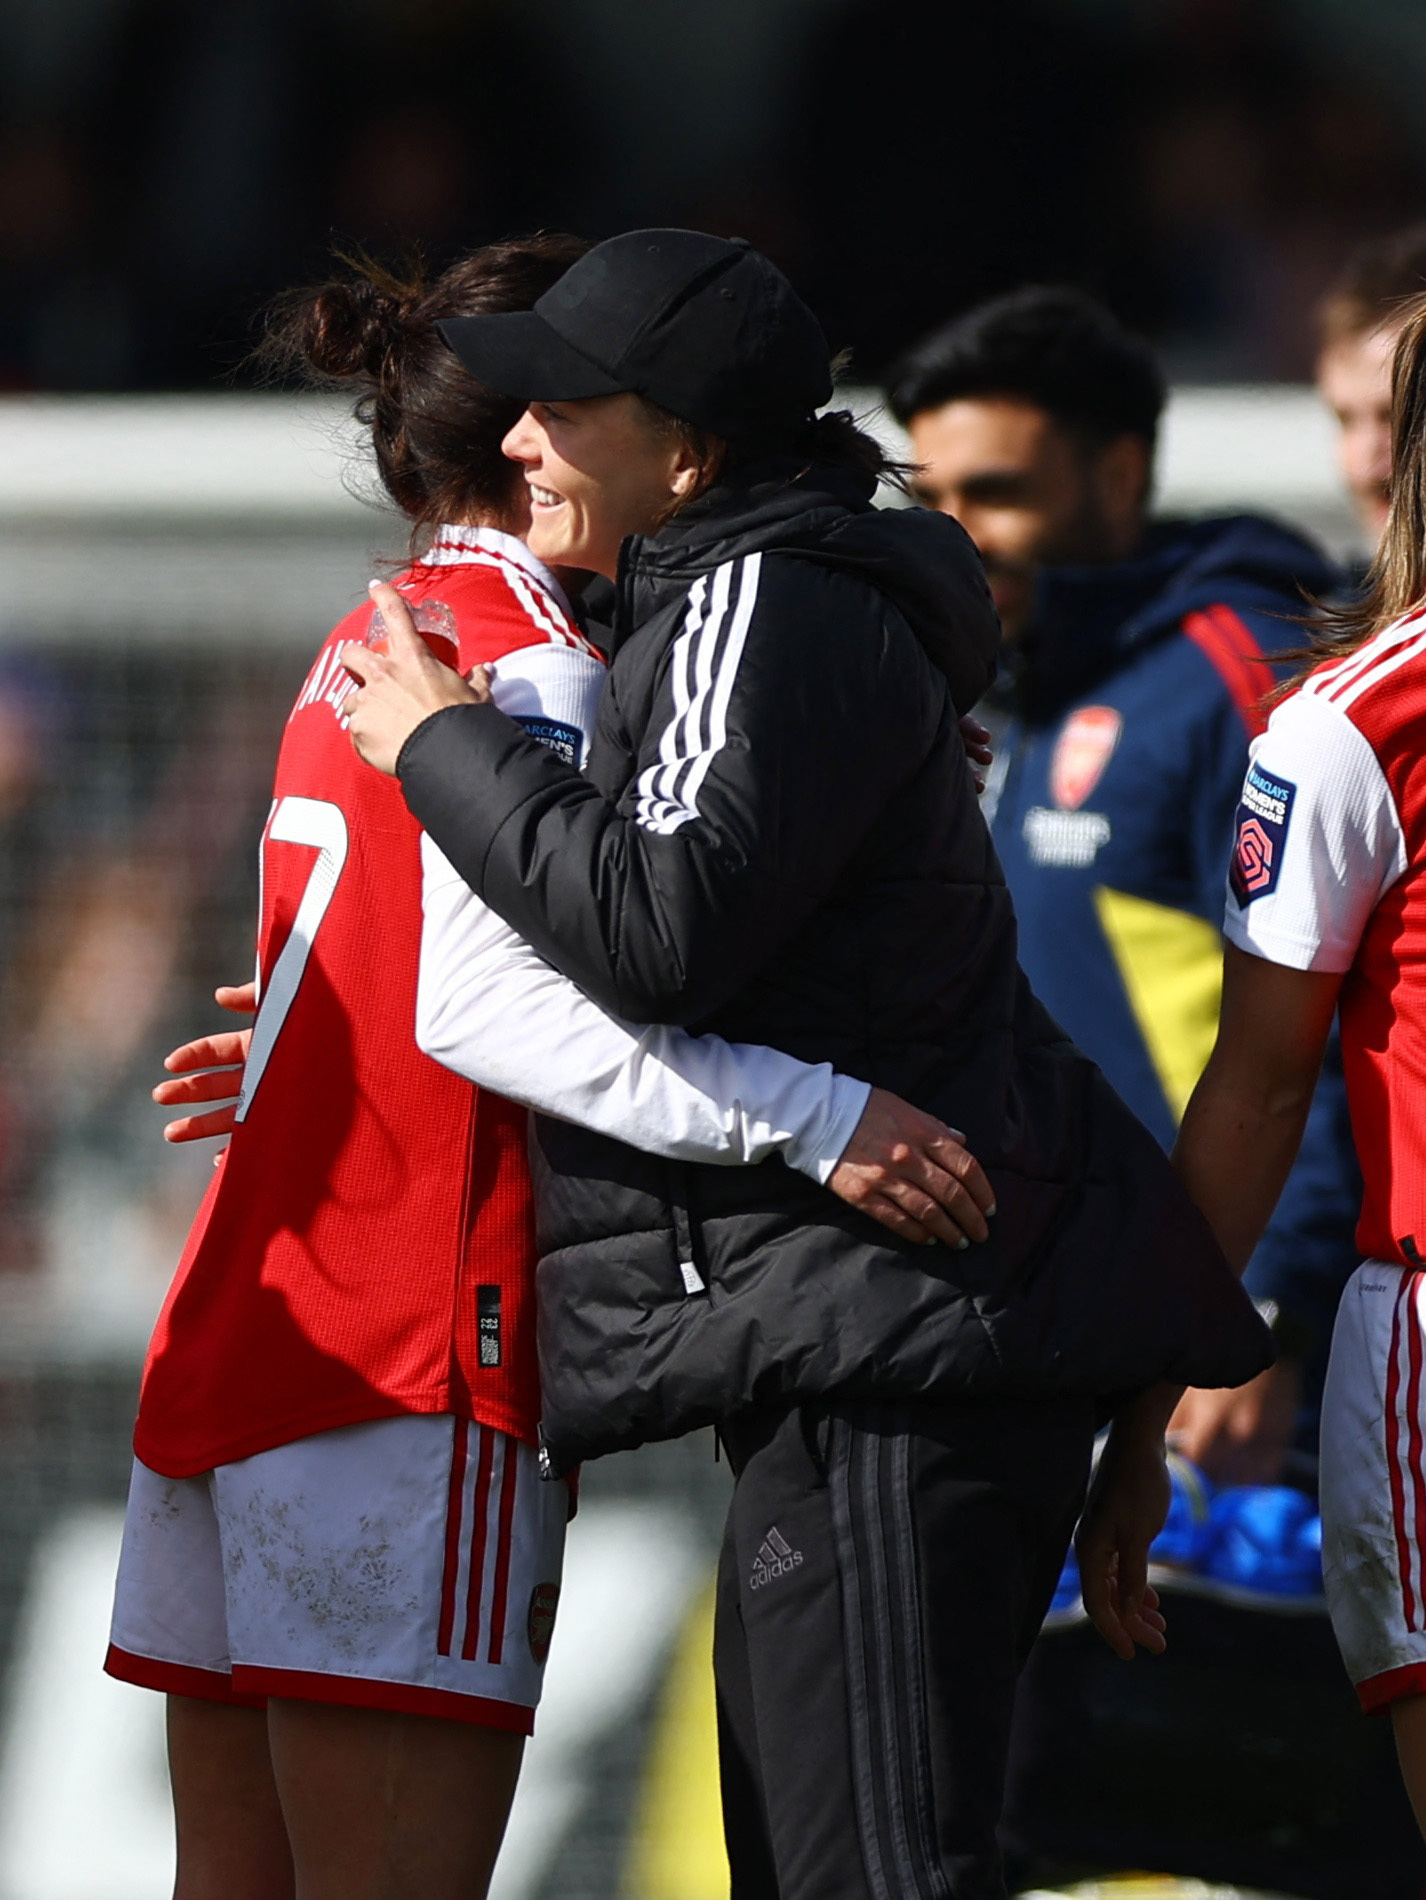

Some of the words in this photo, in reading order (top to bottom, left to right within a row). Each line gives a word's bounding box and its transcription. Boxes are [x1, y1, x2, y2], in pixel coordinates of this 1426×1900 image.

[523, 725, 576, 744] ARCLAYS
[235, 796, 348, 1123] 7
[749, 1551, 804, 1590] adidas
